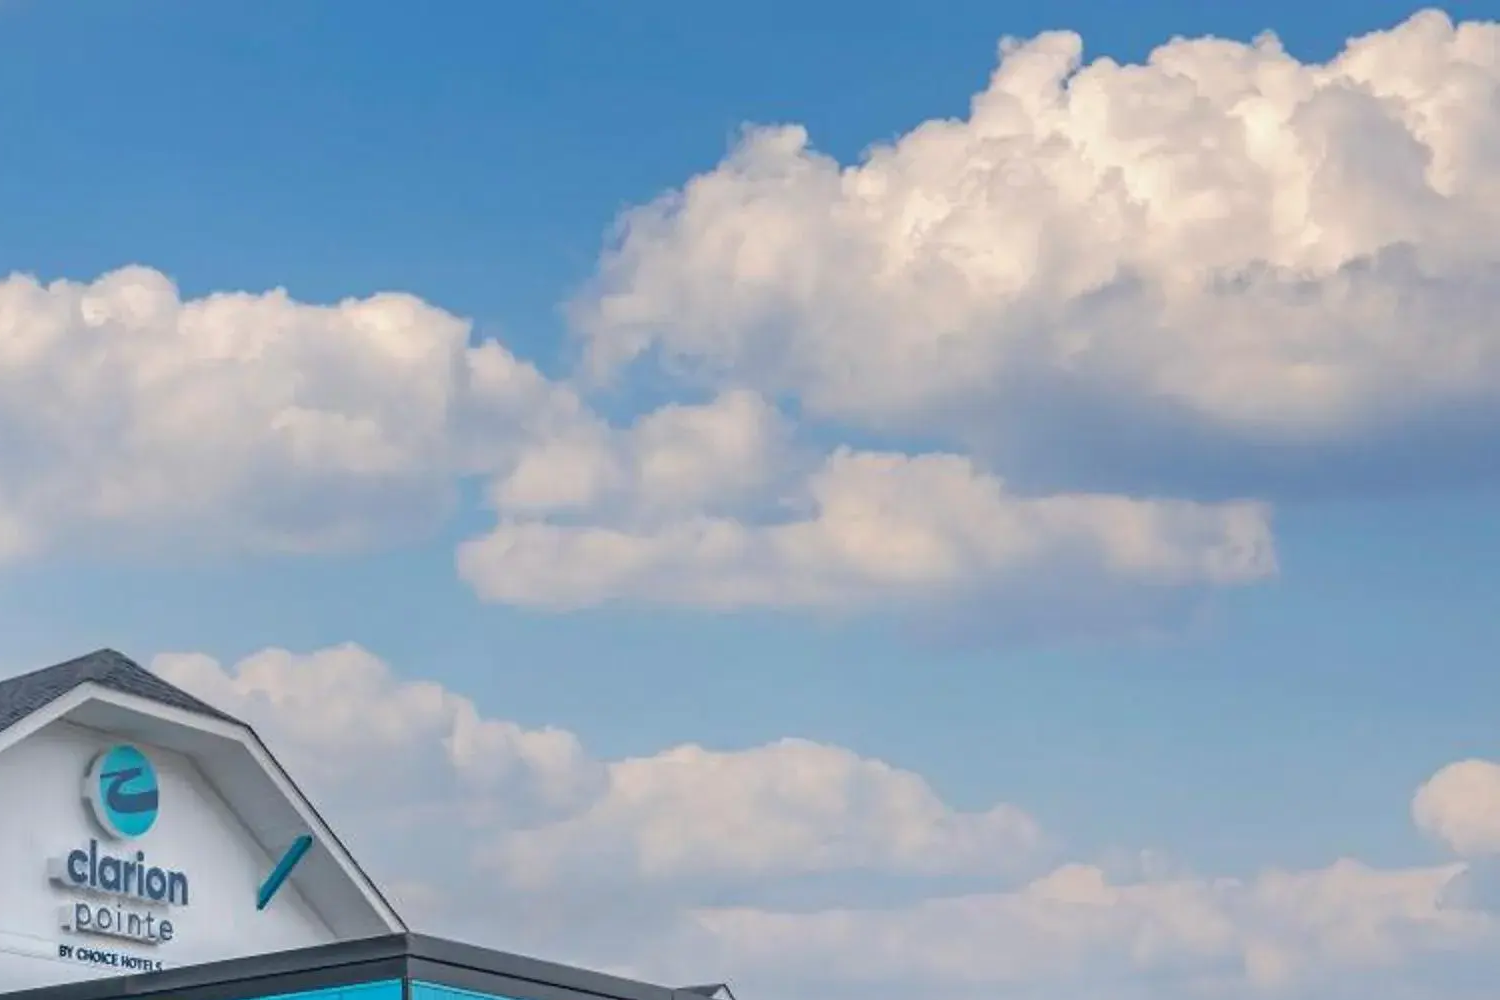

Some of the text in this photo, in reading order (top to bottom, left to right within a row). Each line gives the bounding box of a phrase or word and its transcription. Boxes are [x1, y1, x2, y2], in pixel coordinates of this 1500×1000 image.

[67, 838, 189, 906] clarion
[75, 902, 174, 942] pointe
[59, 944, 163, 973] BY CHOICE HOTELS
